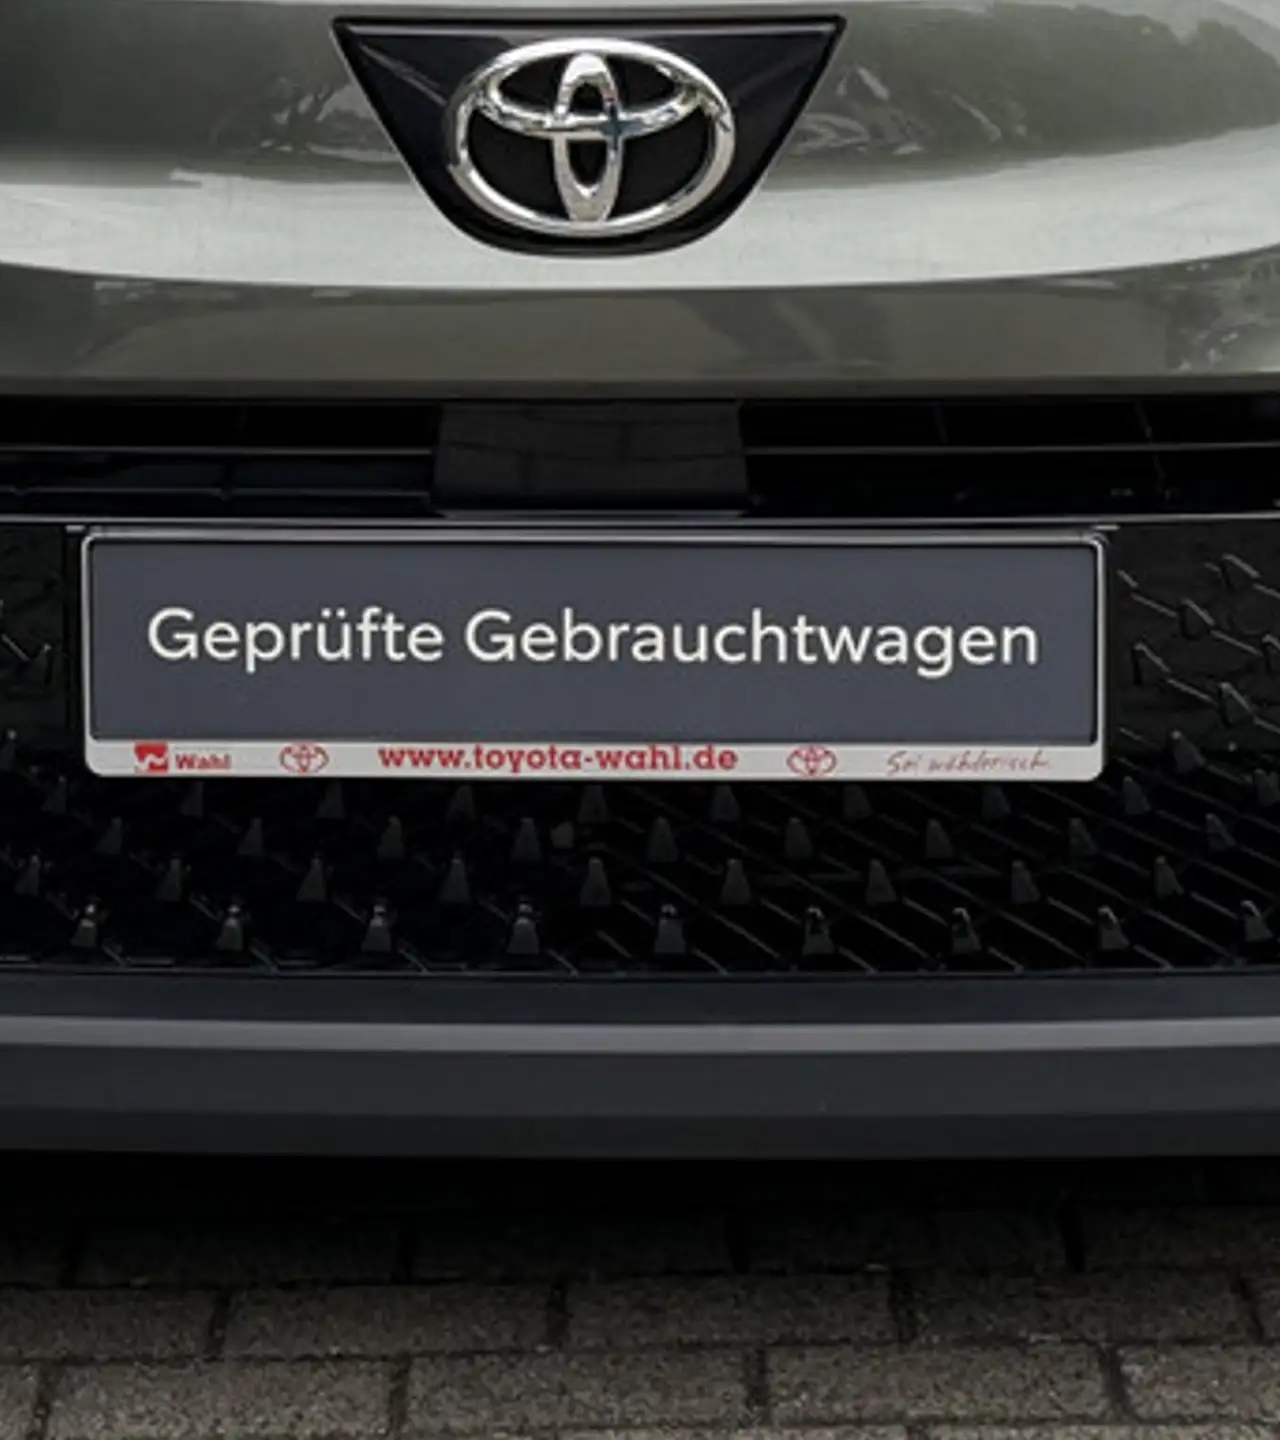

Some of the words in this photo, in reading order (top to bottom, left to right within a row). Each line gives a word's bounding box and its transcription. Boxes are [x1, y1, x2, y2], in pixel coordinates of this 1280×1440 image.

[147, 606, 445, 674] Geprüfte
[464, 607, 1039, 679] Gebrauchtwagen
[175, 753, 232, 770] Wahl
[377, 744, 739, 773] www.toyota-wahl.de
